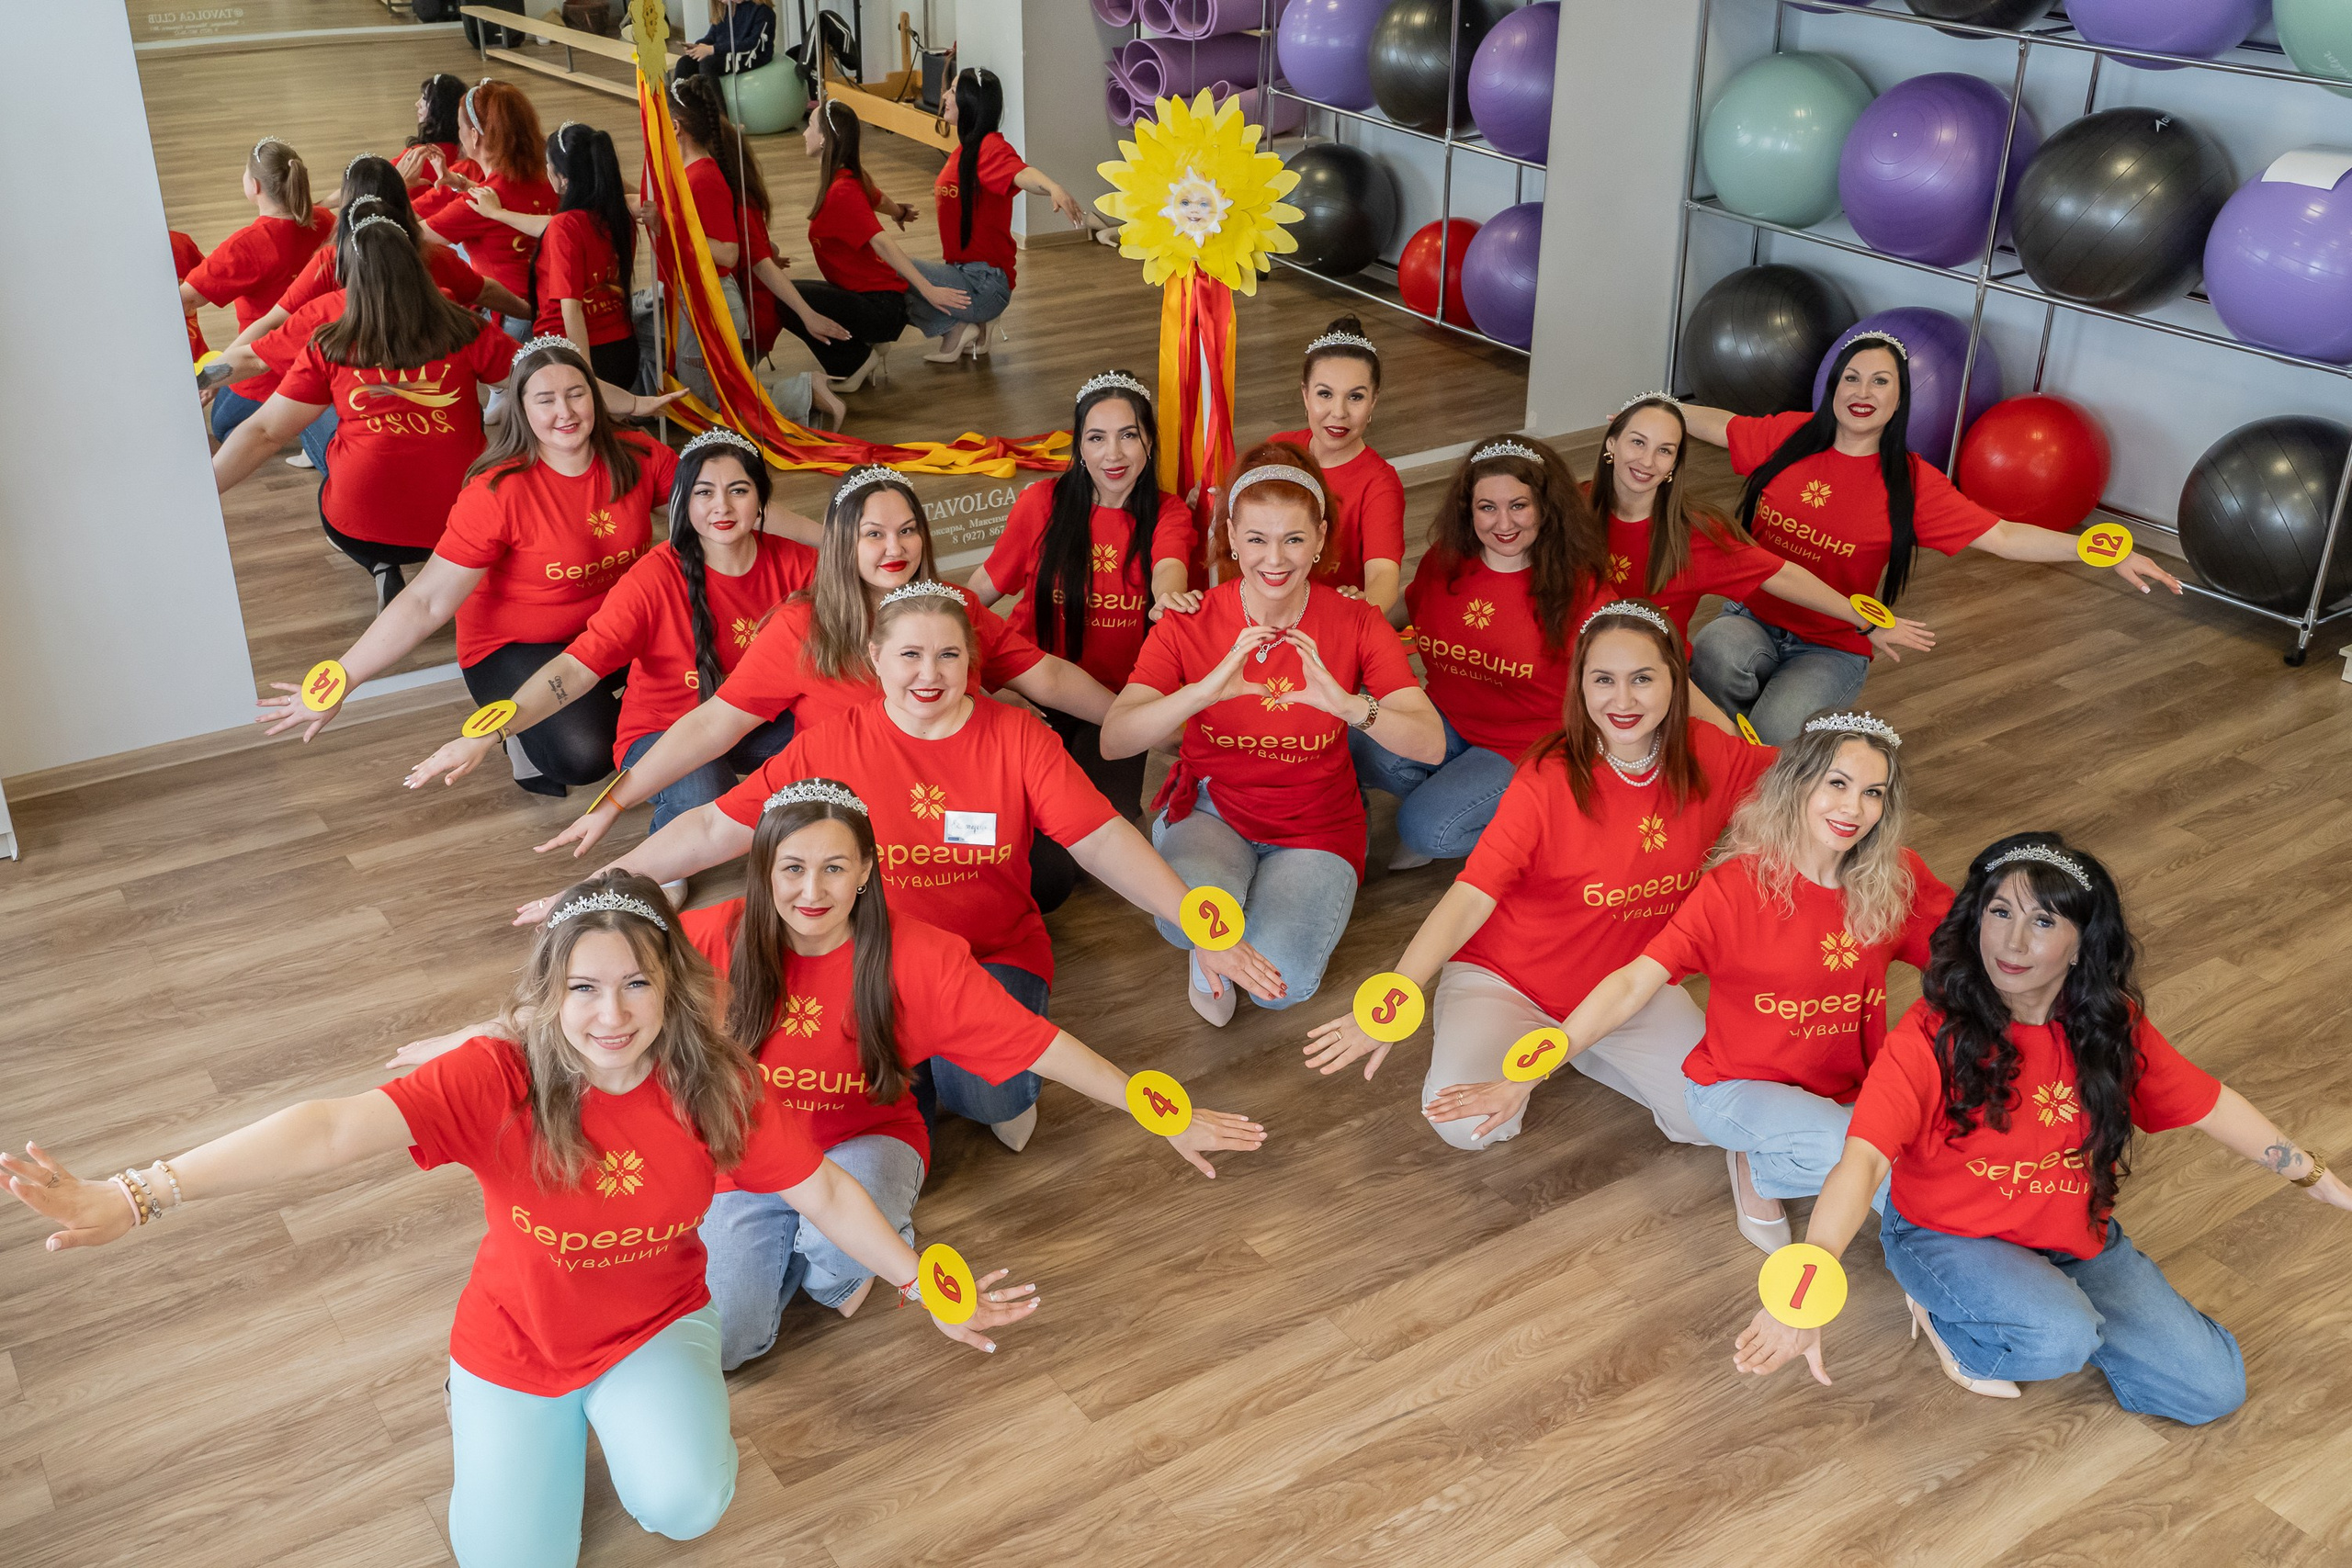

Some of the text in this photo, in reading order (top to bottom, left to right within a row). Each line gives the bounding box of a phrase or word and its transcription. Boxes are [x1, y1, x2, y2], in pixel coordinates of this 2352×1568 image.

[922, 486, 1017, 522] TAVOLGA
[930, 524, 966, 537] оксары,
[952, 535, 959, 545] 8
[962, 529, 986, 545] (927)
[2086, 531, 2126, 558] 12
[1859, 599, 1887, 625] 10
[309, 667, 341, 705] 14
[470, 707, 507, 732] 11
[876, 842, 1012, 871] ерегиня
[1198, 899, 1230, 940] 2
[1371, 987, 1409, 1024] 5
[782, 1098, 845, 1112] ашии
[1142, 1087, 1180, 1118] 4
[511, 1204, 711, 1255] берегин
[933, 1261, 962, 1304] 6
[1789, 1263, 1818, 1310] 1
